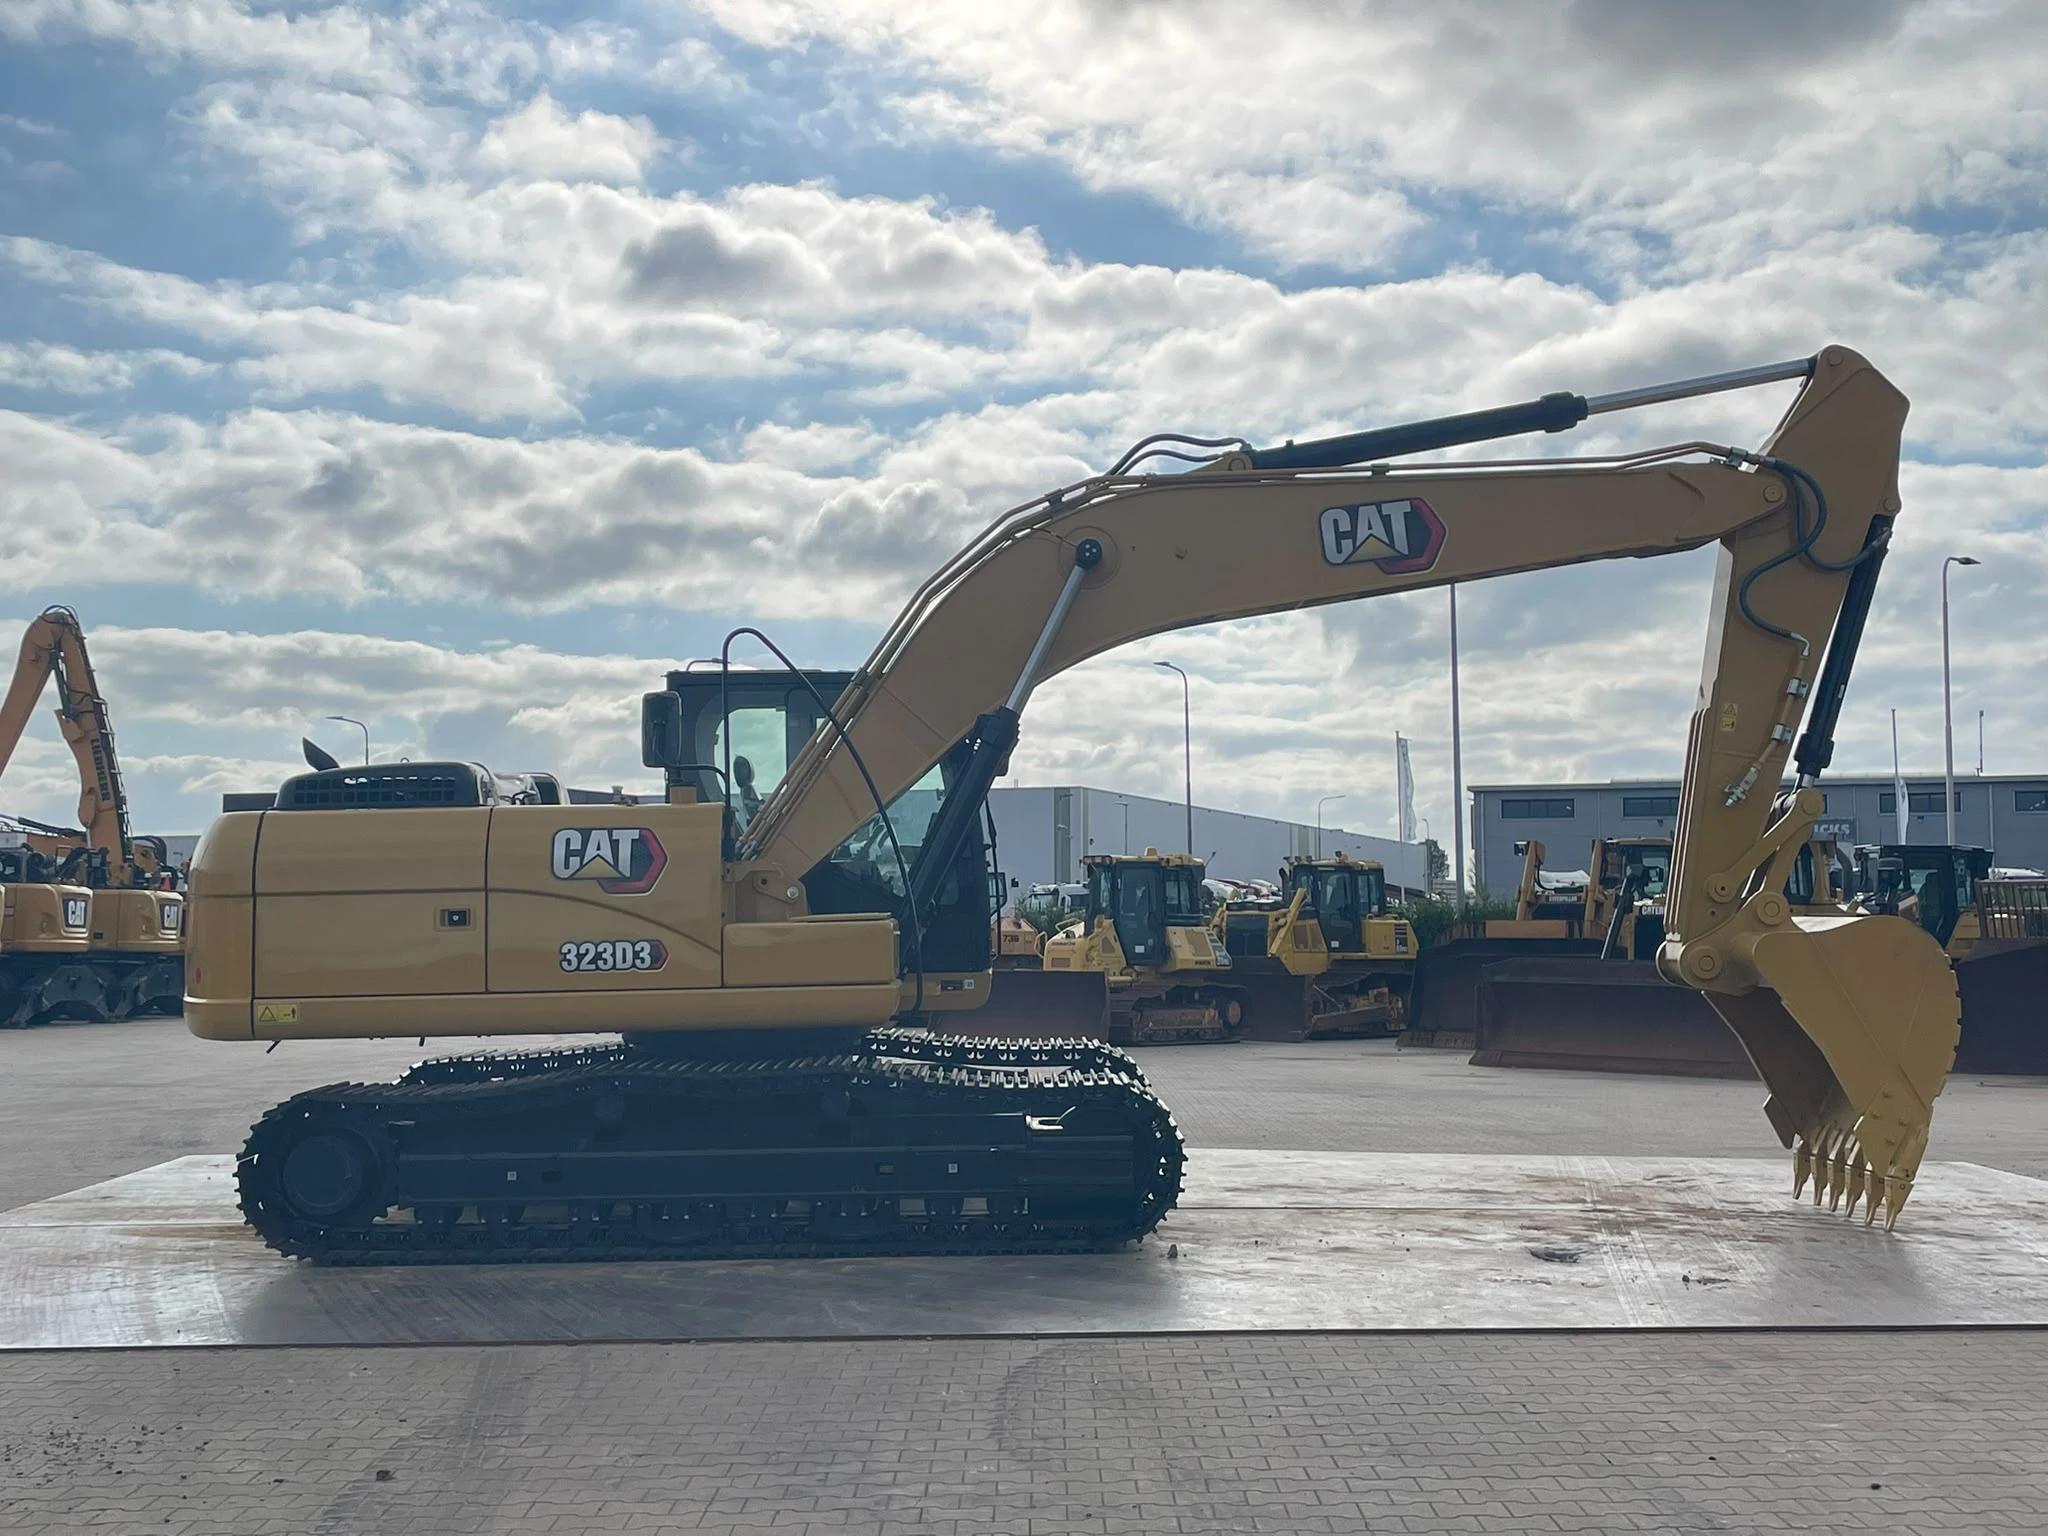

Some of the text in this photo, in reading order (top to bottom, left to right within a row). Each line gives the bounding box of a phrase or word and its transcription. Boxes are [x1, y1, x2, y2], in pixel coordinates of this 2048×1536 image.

[1320, 499, 1412, 566] CAT
[552, 828, 641, 879] CAT
[67, 900, 87, 926] CAT
[164, 904, 179, 928] CAT
[560, 940, 652, 972] 323D3
